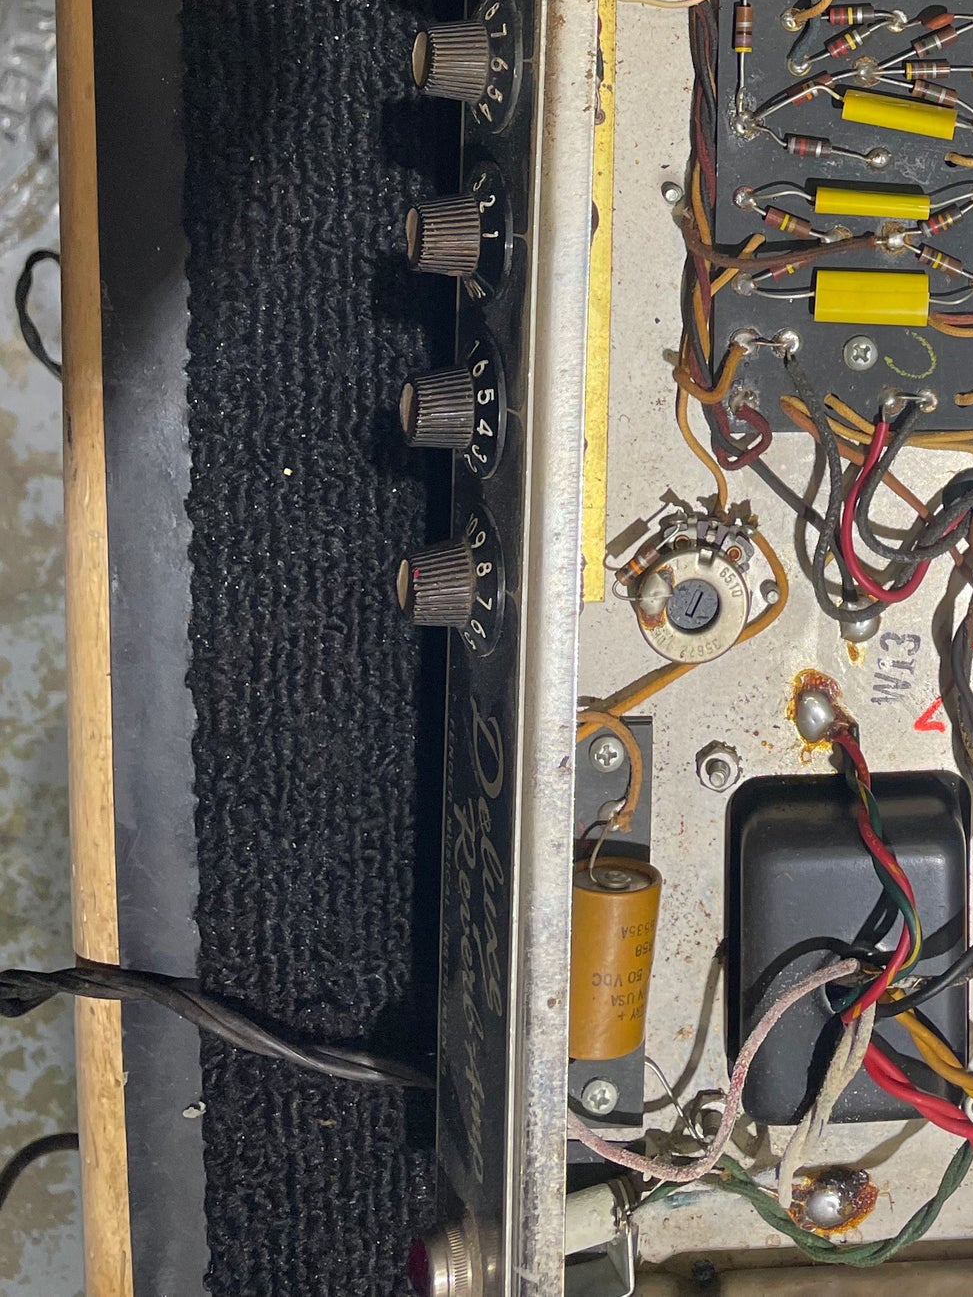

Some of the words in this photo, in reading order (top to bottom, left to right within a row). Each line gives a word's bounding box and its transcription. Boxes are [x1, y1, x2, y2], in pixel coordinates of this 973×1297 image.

[490, 23, 507, 38] 7
[490, 57, 508, 72] 6
[486, 84, 503, 102] 5
[479, 194, 496, 213] 2
[481, 230, 499, 238] 1
[472, 359, 489, 377] 6
[477, 388, 495, 405] 5
[476, 419, 493, 437] 4
[471, 444, 487, 463] 3
[471, 531, 487, 548] 9
[476, 562, 492, 577] 8
[719, 567, 744, 599] 6510
[476, 596, 493, 611] 7
[470, 619, 487, 639] 6
[470, 695, 504, 1017] Deluxe
[592, 972, 623, 988] VDC
[611, 992, 635, 1007] USA
